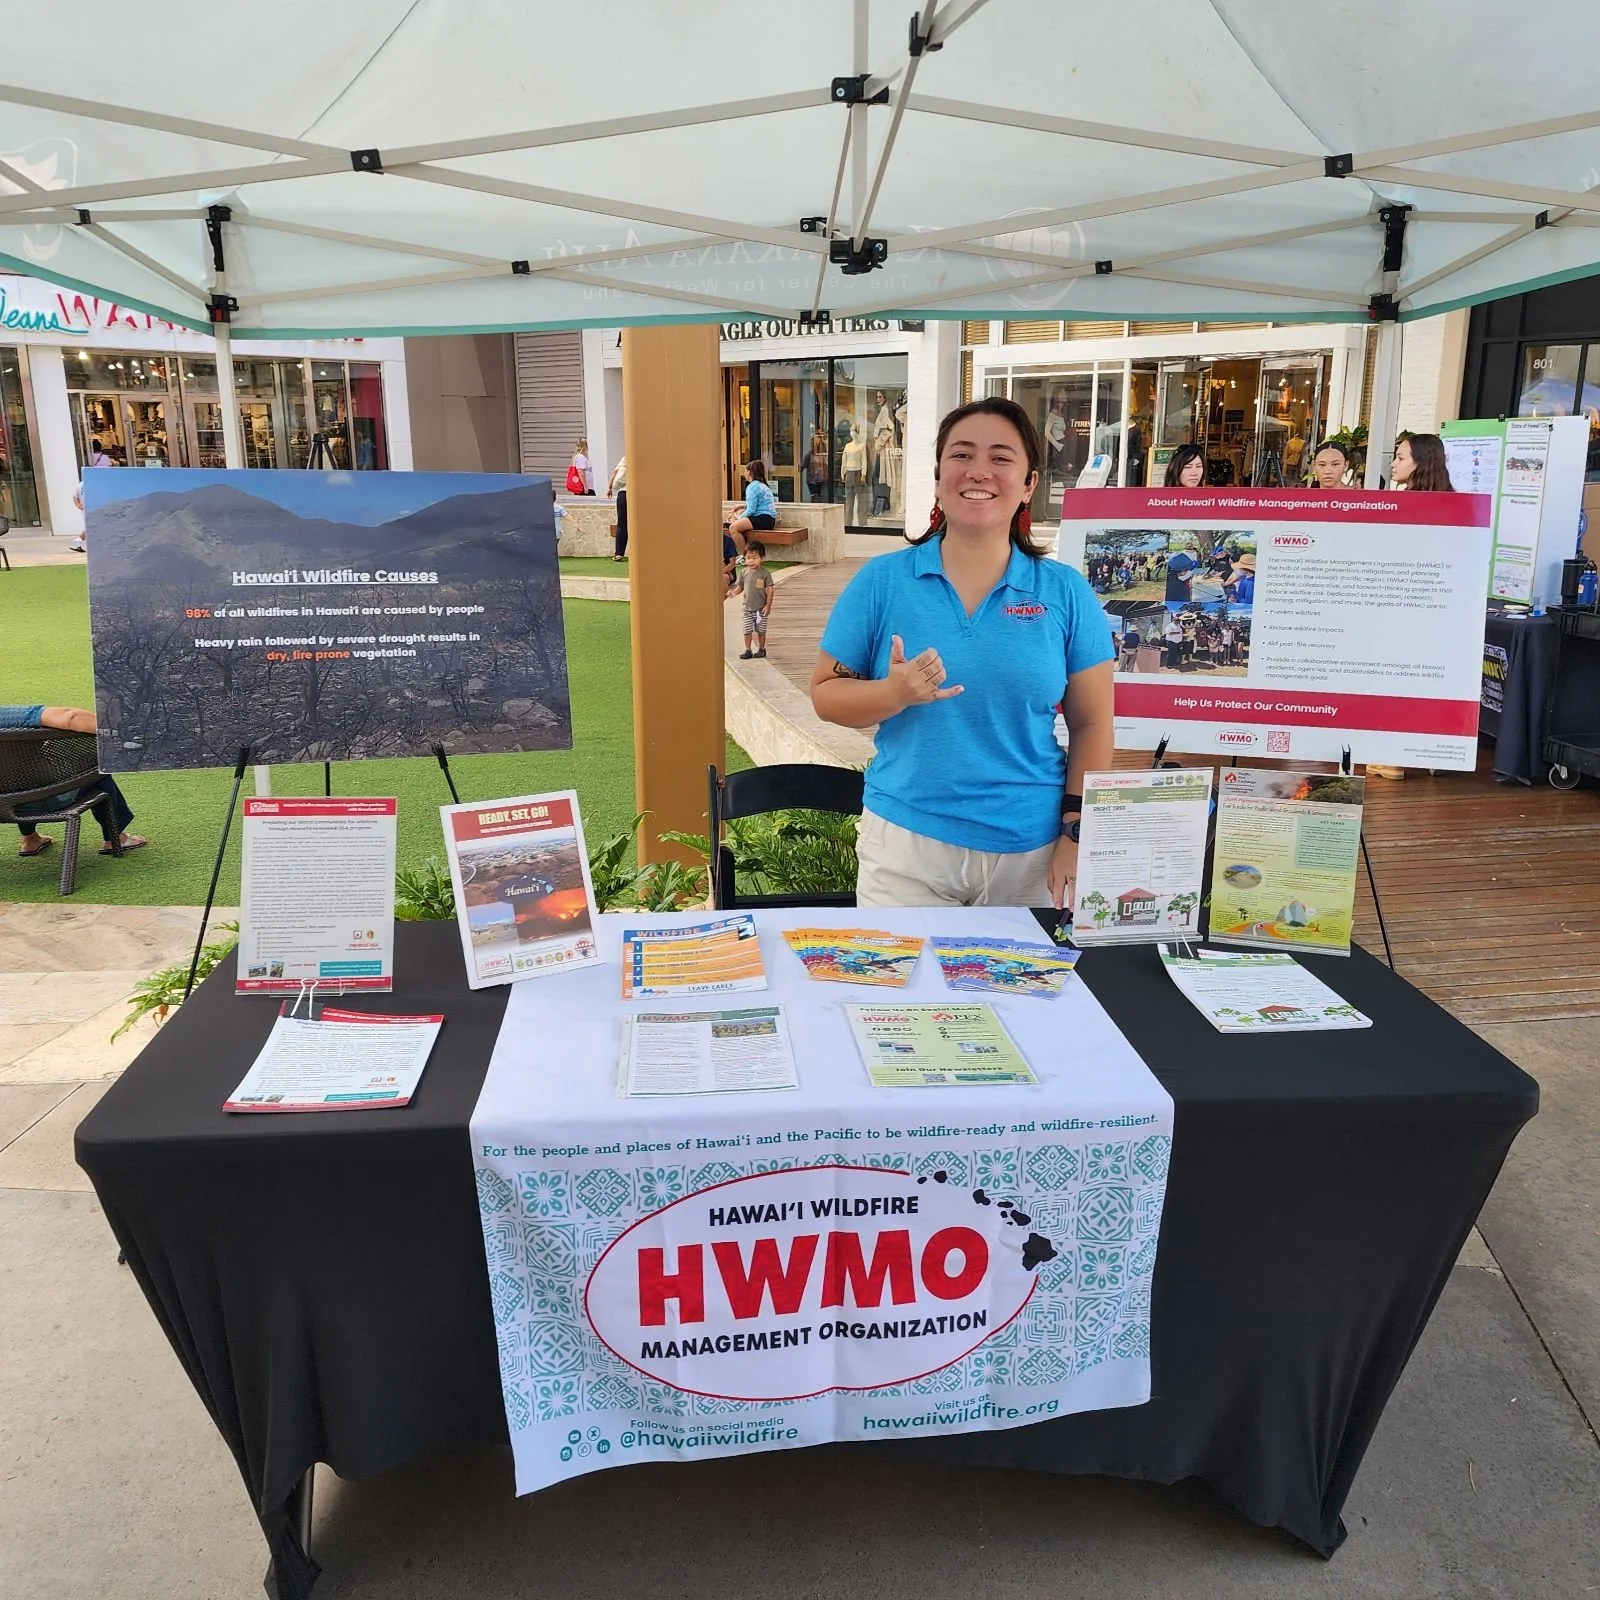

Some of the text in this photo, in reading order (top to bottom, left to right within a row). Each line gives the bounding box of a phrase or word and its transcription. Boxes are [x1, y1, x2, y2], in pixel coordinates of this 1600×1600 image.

[1533, 358, 1553, 369] 801
[1147, 498, 1398, 512] About Hawai'i Wildfire Management Organization
[1274, 537, 1308, 545] HWMO
[232, 570, 438, 584] Hawai'i Wildfire Causes
[186, 608, 210, 618] 98%
[214, 608, 227, 618] of
[229, 608, 245, 617] all
[246, 607, 299, 616] wildfires
[301, 607, 313, 616] in
[384, 605, 426, 614] caused
[429, 605, 443, 616] by
[446, 605, 484, 615] people
[1006, 606, 1042, 615] HWMO
[194, 632, 480, 649] Heavy rain followed by severe drought results in
[266, 648, 416, 662] dry, fire prone vegetation
[1174, 697, 1338, 717] Help Us Protect Our Community
[1220, 734, 1252, 743] HWMO
[478, 806, 549, 826] READY, SET, GO!
[505, 883, 540, 896] Hawai'i
[636, 929, 702, 937] WILDFIRE
[482, 1114, 1158, 1158] For the people and places of Hawai'i and the Pacific to be wildfire-ready and wildfire-resilient.
[709, 1196, 919, 1226] HAWAI'I WILDFIRE
[638, 1226, 989, 1327] HWMO
[641, 1310, 987, 1360] MANAGEMENT ORGANIZATION
[934, 1393, 990, 1410] Visit us at
[863, 1399, 1059, 1429] hawaiiwildfire.org
[630, 1417, 784, 1434] Follow us on social media
[621, 1427, 799, 1449] @hawaiiwildfire
